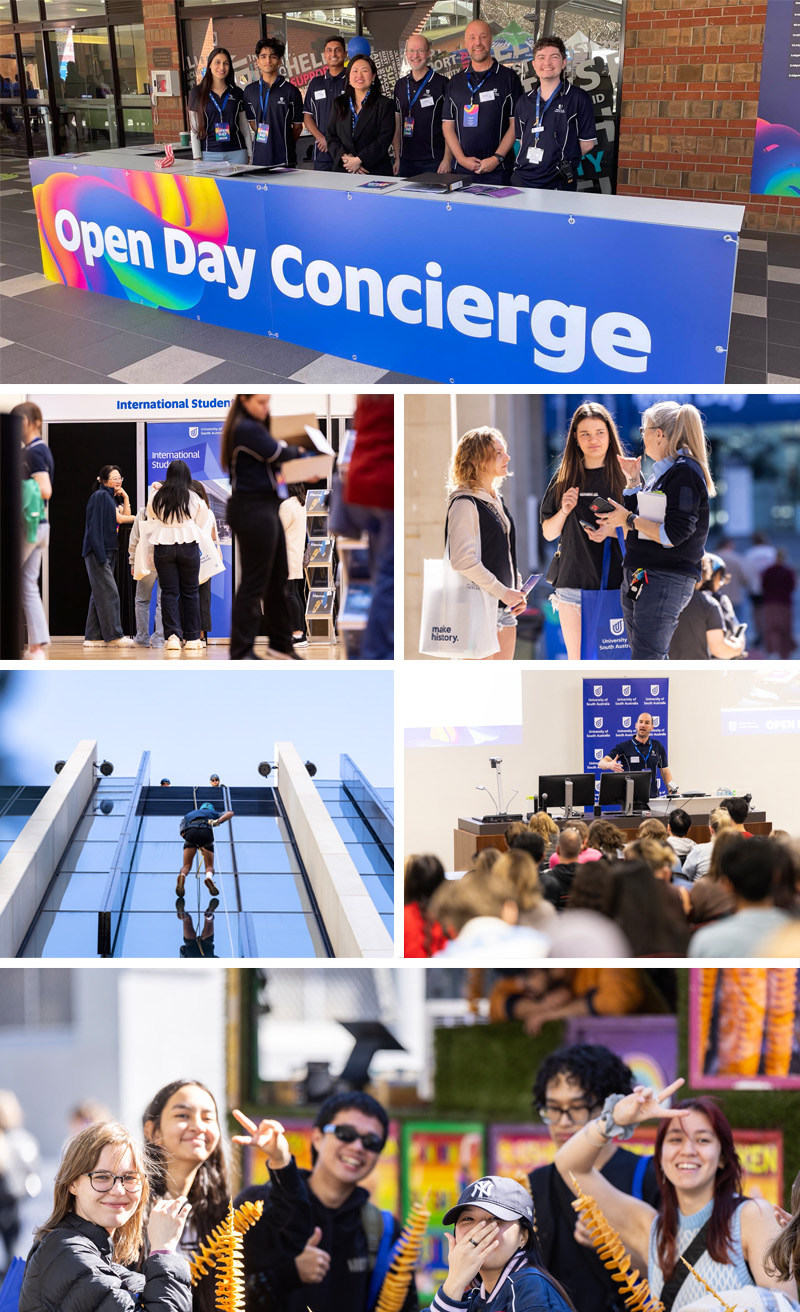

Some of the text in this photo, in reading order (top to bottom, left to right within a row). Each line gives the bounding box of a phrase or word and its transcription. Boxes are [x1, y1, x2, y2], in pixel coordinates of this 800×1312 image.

[55, 209, 652, 374] Open Day Concierge
[116, 398, 189, 410] International
[151, 450, 200, 459] International
[432, 625, 452, 633] make
[431, 632, 459, 644] history.
[765, 719, 795, 730] OPEN
